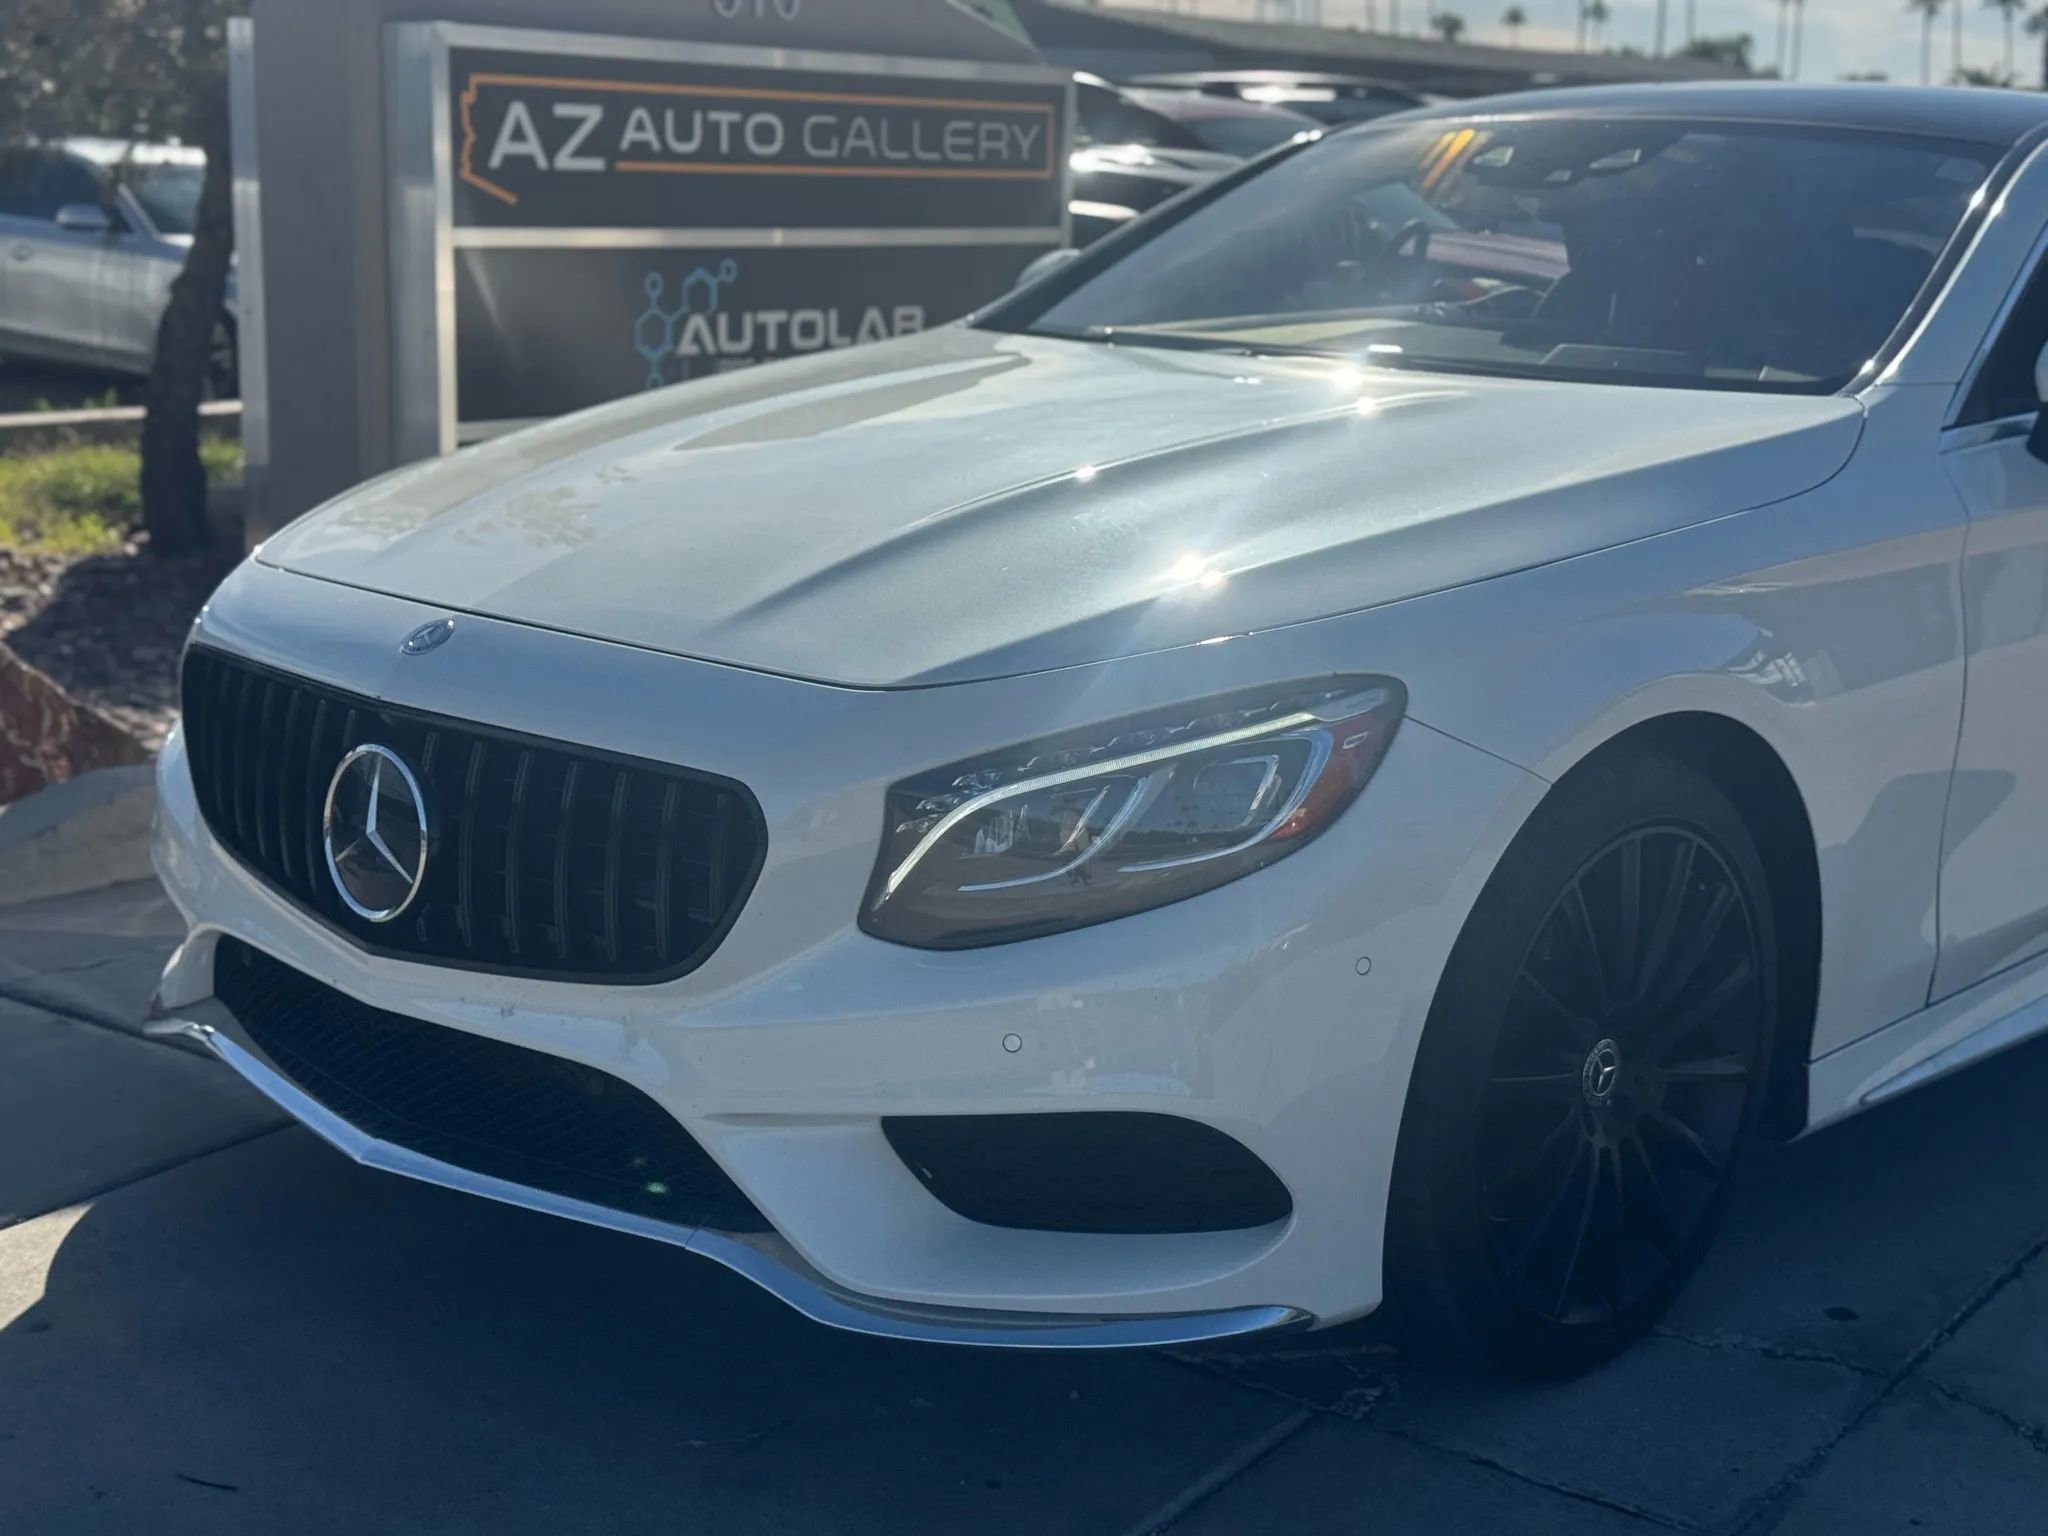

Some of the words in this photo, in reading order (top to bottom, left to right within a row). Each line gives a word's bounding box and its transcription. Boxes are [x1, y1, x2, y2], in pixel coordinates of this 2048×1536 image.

[487, 100, 606, 171] AZ
[619, 107, 785, 156] AUTO
[803, 115, 1041, 162] GALLERY
[676, 305, 925, 355] AUTOLAB
